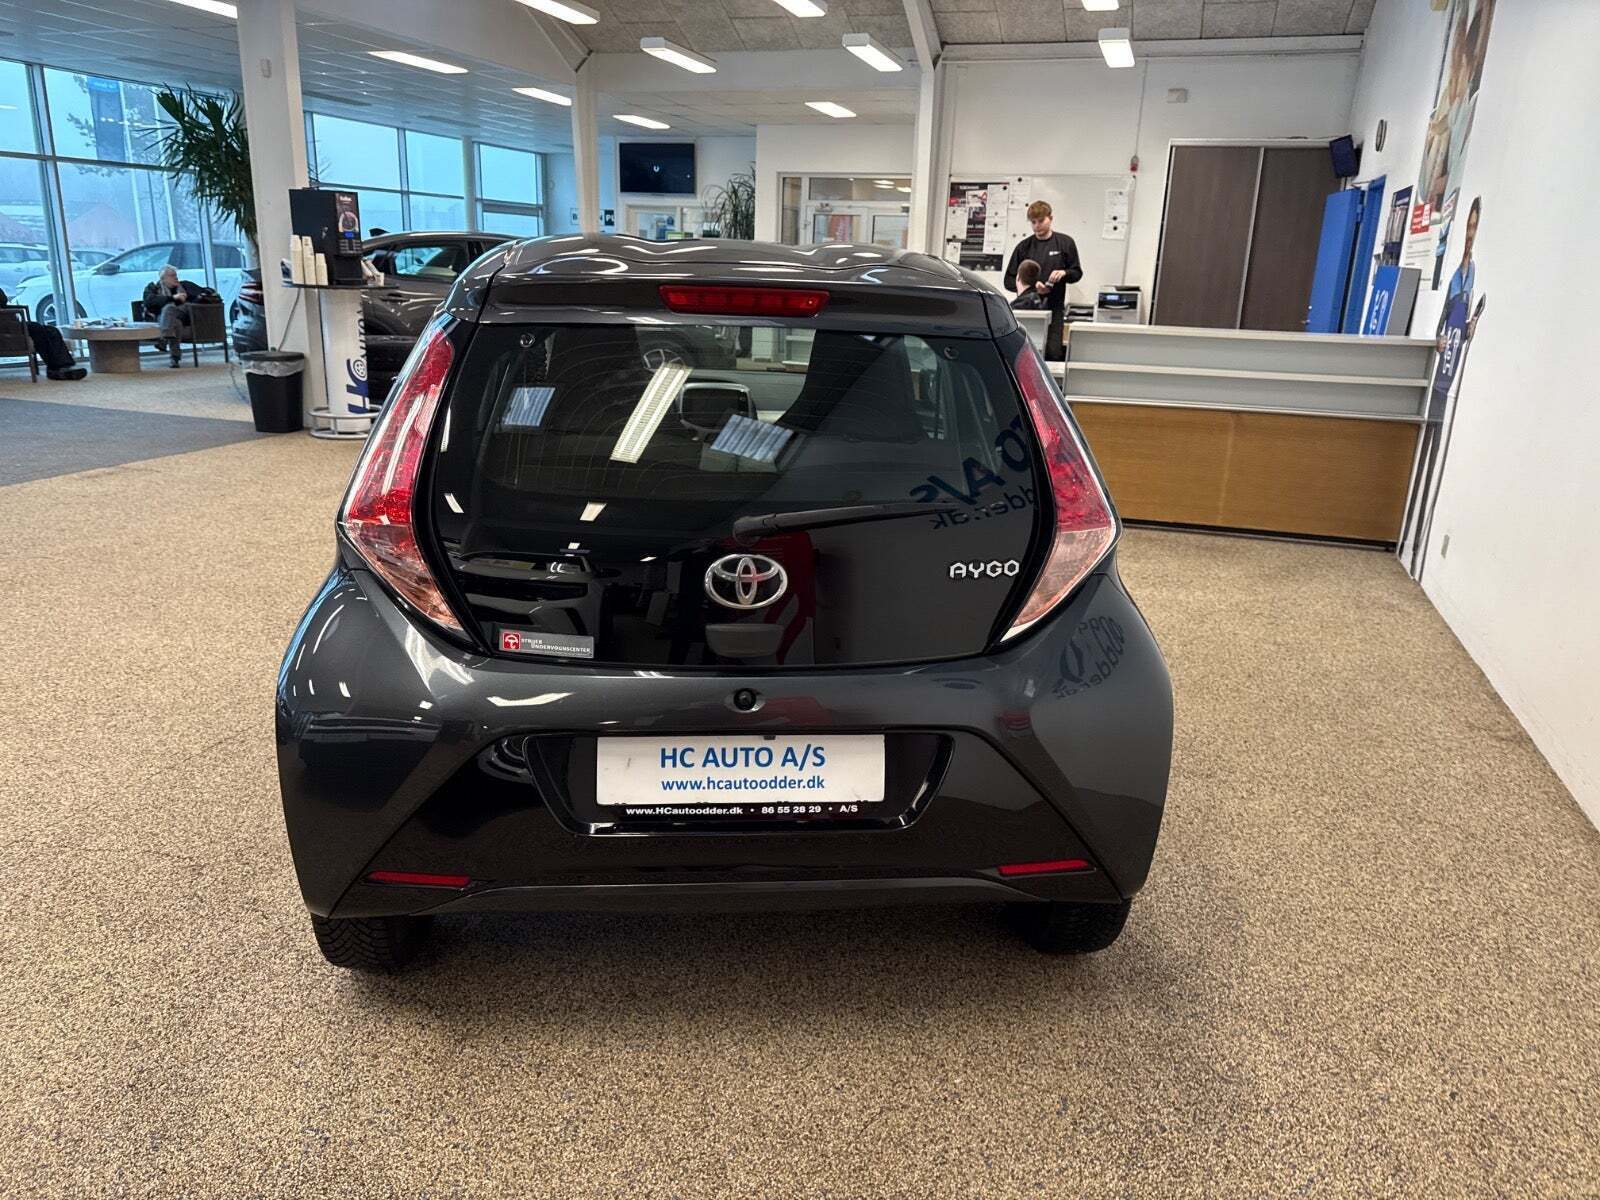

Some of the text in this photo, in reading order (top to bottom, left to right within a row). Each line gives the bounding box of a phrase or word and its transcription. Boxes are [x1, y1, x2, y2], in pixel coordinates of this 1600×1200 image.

[949, 560, 1020, 579] AYGO
[660, 743, 826, 771] HC AUTO A/S
[661, 775, 825, 791] www.hcautoodder.dk
[625, 804, 859, 816] www.HCautoodder.dk 86 55 28 29 A/S
